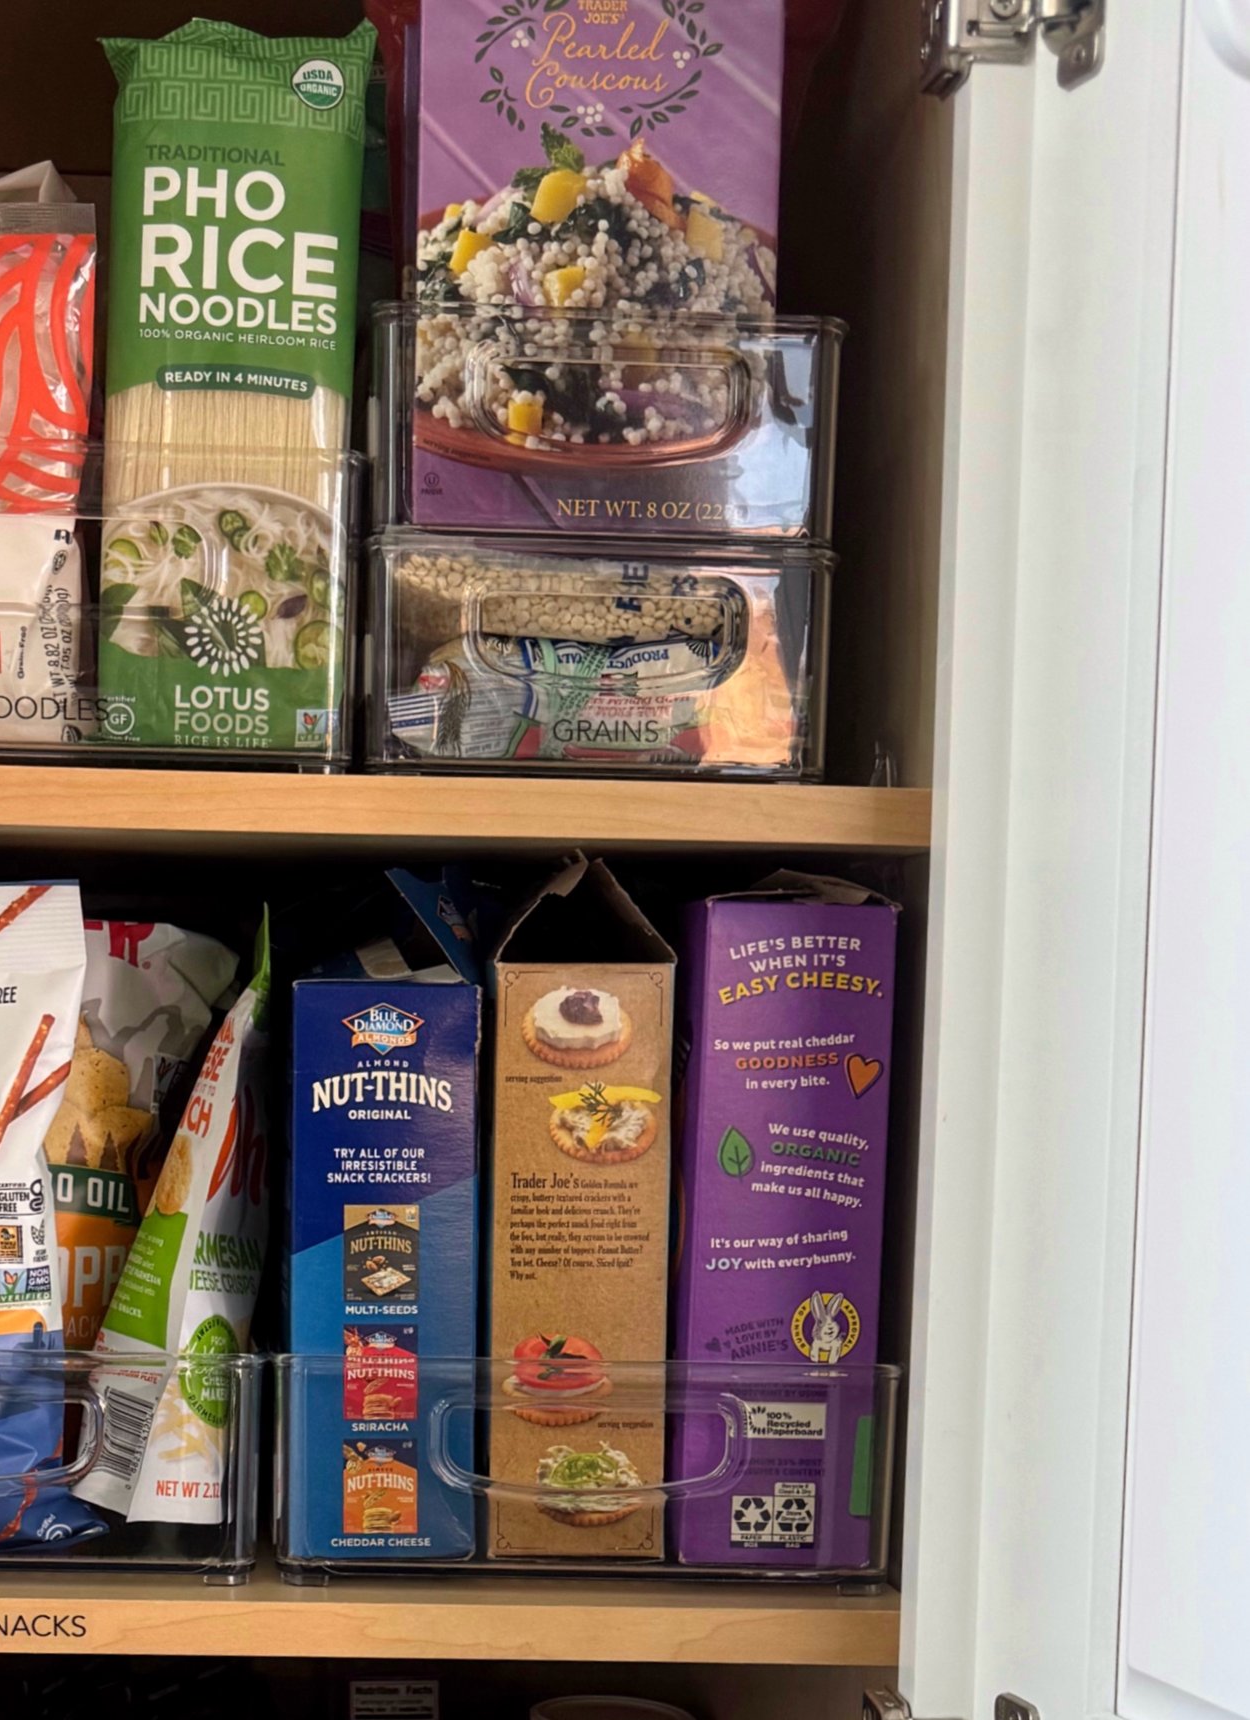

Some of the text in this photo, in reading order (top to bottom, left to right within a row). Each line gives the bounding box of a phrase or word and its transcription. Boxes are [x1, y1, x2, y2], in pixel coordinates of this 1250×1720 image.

[533, 12, 670, 66] Pearled
[302, 68, 334, 82] USDA
[525, 61, 668, 109] Couscous
[300, 83, 338, 97] ORGANIC
[146, 144, 286, 167] TRADITIONAL
[143, 166, 286, 221] PHO
[140, 223, 339, 299] RICE
[138, 293, 338, 336] NOODLES
[139, 328, 337, 351] 100% ORGANIC HEIRLOOM RICE
[165, 370, 308, 393] READY IN 4 MINUTES
[174, 684, 270, 711] LOTUS
[174, 711, 270, 735] FOODS
[552, 718, 659, 744] GRAINS
[730, 935, 862, 961] LIFE'S BETTER
[749, 954, 846, 973] WHEN IT'S
[718, 971, 884, 1006] EASY CHEESY.
[354, 1018, 415, 1032] DIAMOND
[714, 1032, 855, 1053] So we put real cheddar
[735, 1052, 839, 1071] GOODNESS
[312, 1070, 454, 1113] NUT-THINS
[746, 1074, 830, 1091] in every bite.
[348, 1110, 411, 1120] ORIGINAL
[768, 1123, 870, 1150] We use quality,
[334, 1148, 425, 1159] TRY ALL OF OUR
[771, 1140, 861, 1168] ORGANIC
[341, 1160, 417, 1171] IRRESISTIBLE
[761, 1161, 866, 1188] ingredients that
[327, 1173, 431, 1184] SNACK CRACKERS!
[511, 1172, 580, 1189] Trader Joe's
[87, 1175, 130, 1214] OIL
[751, 1181, 863, 1208] make us all happy.
[710, 1229, 848, 1250] It's our way of sharing
[705, 1250, 857, 1272] JOY with everybunny.
[345, 1305, 418, 1315] MULTI-SEEDS
[352, 1422, 408, 1432] SRIRACHA
[766, 1427, 823, 1438] Paperboard
[331, 1538, 431, 1548] CHEDDAR CHEESE
